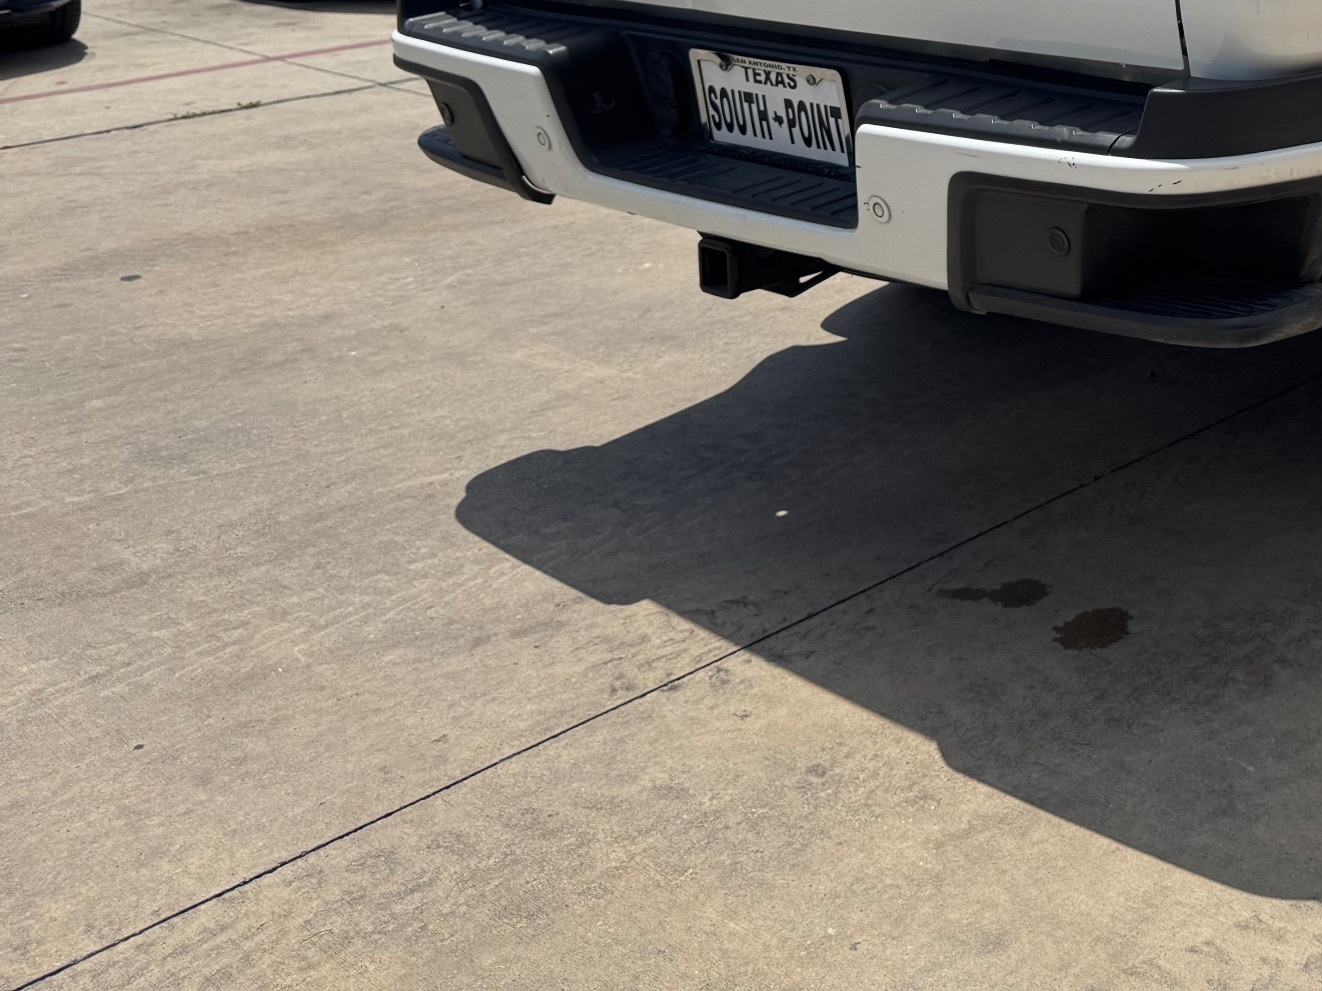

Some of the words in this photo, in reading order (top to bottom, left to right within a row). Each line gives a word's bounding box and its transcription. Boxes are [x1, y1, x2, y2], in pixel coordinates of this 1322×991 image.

[740, 65, 798, 90] TEXAS
[707, 84, 774, 141] SOUTH
[783, 97, 846, 154] POINT
